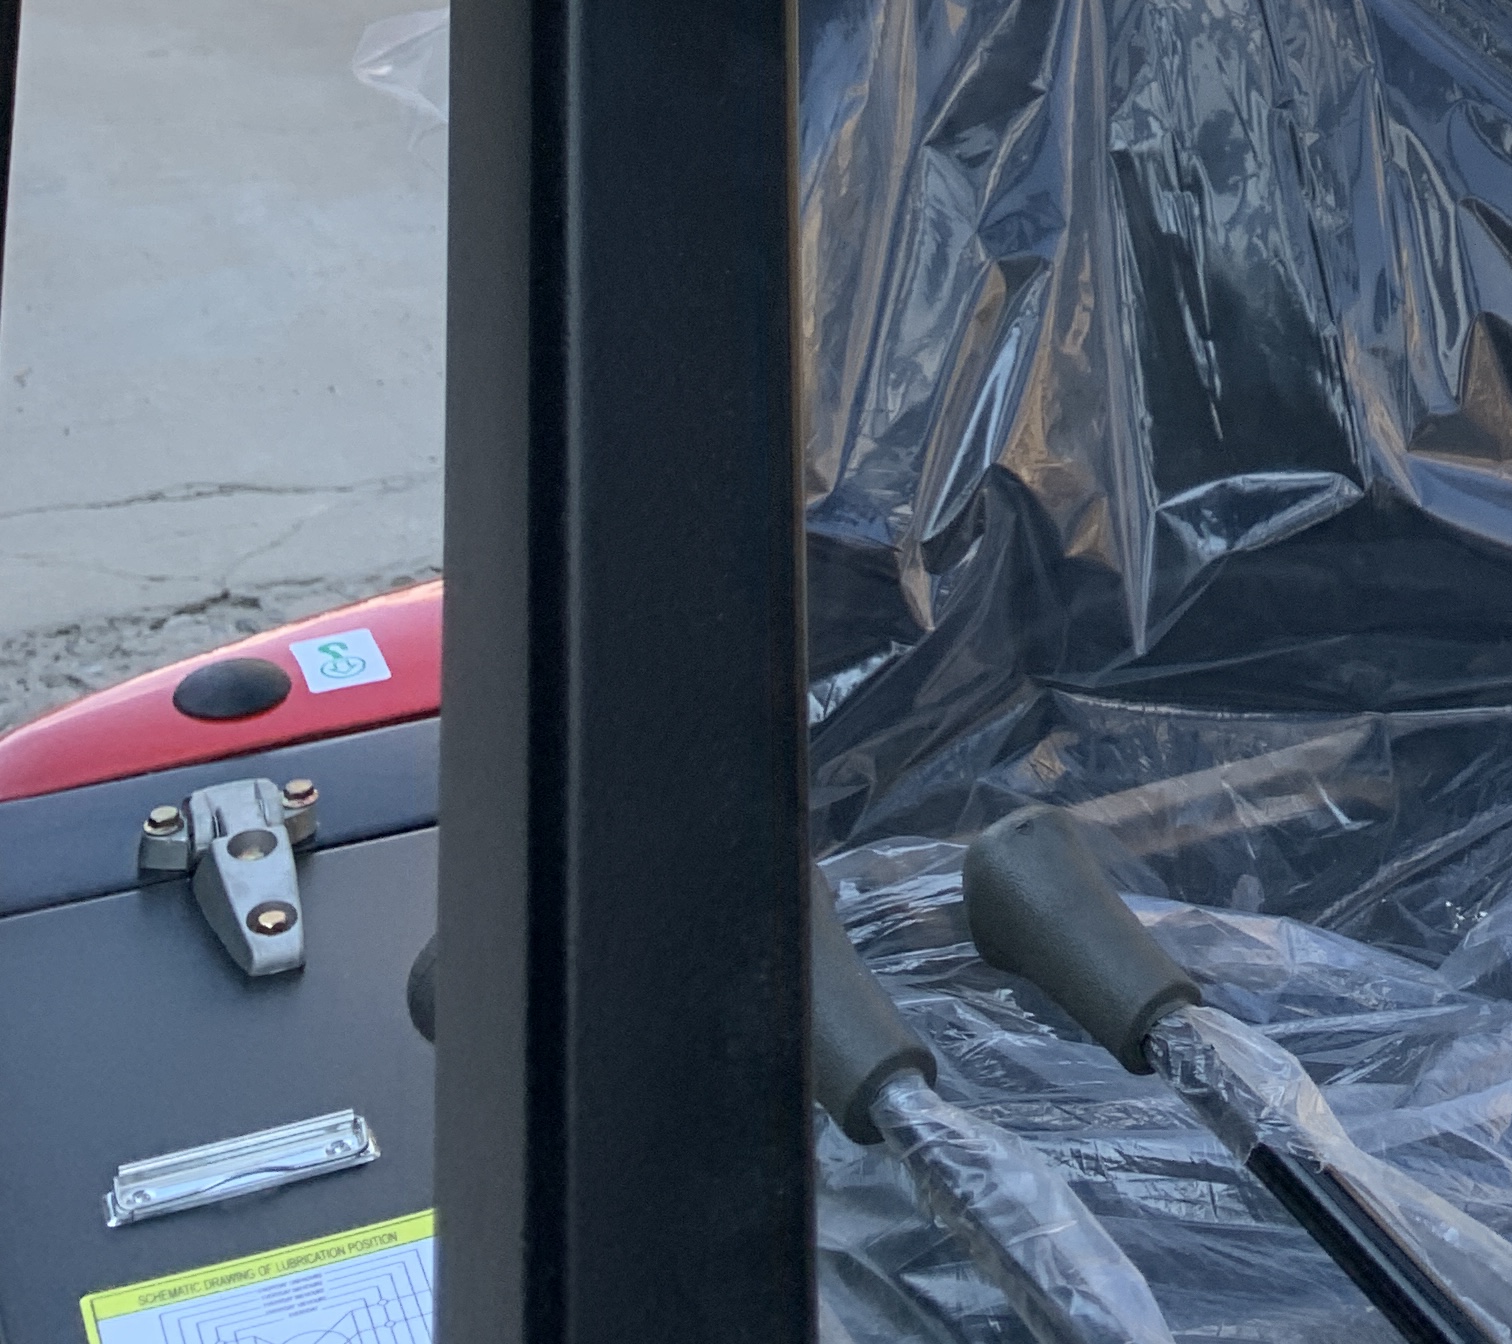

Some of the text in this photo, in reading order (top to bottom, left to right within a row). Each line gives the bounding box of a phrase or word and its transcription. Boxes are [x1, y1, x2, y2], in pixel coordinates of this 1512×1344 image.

[138, 1283, 200, 1306] SCHEMATIC
[204, 1269, 256, 1288] DRAWING
[258, 1263, 271, 1277] OF
[276, 1247, 346, 1271] LUBRICATION
[347, 1232, 398, 1253] POSITION
